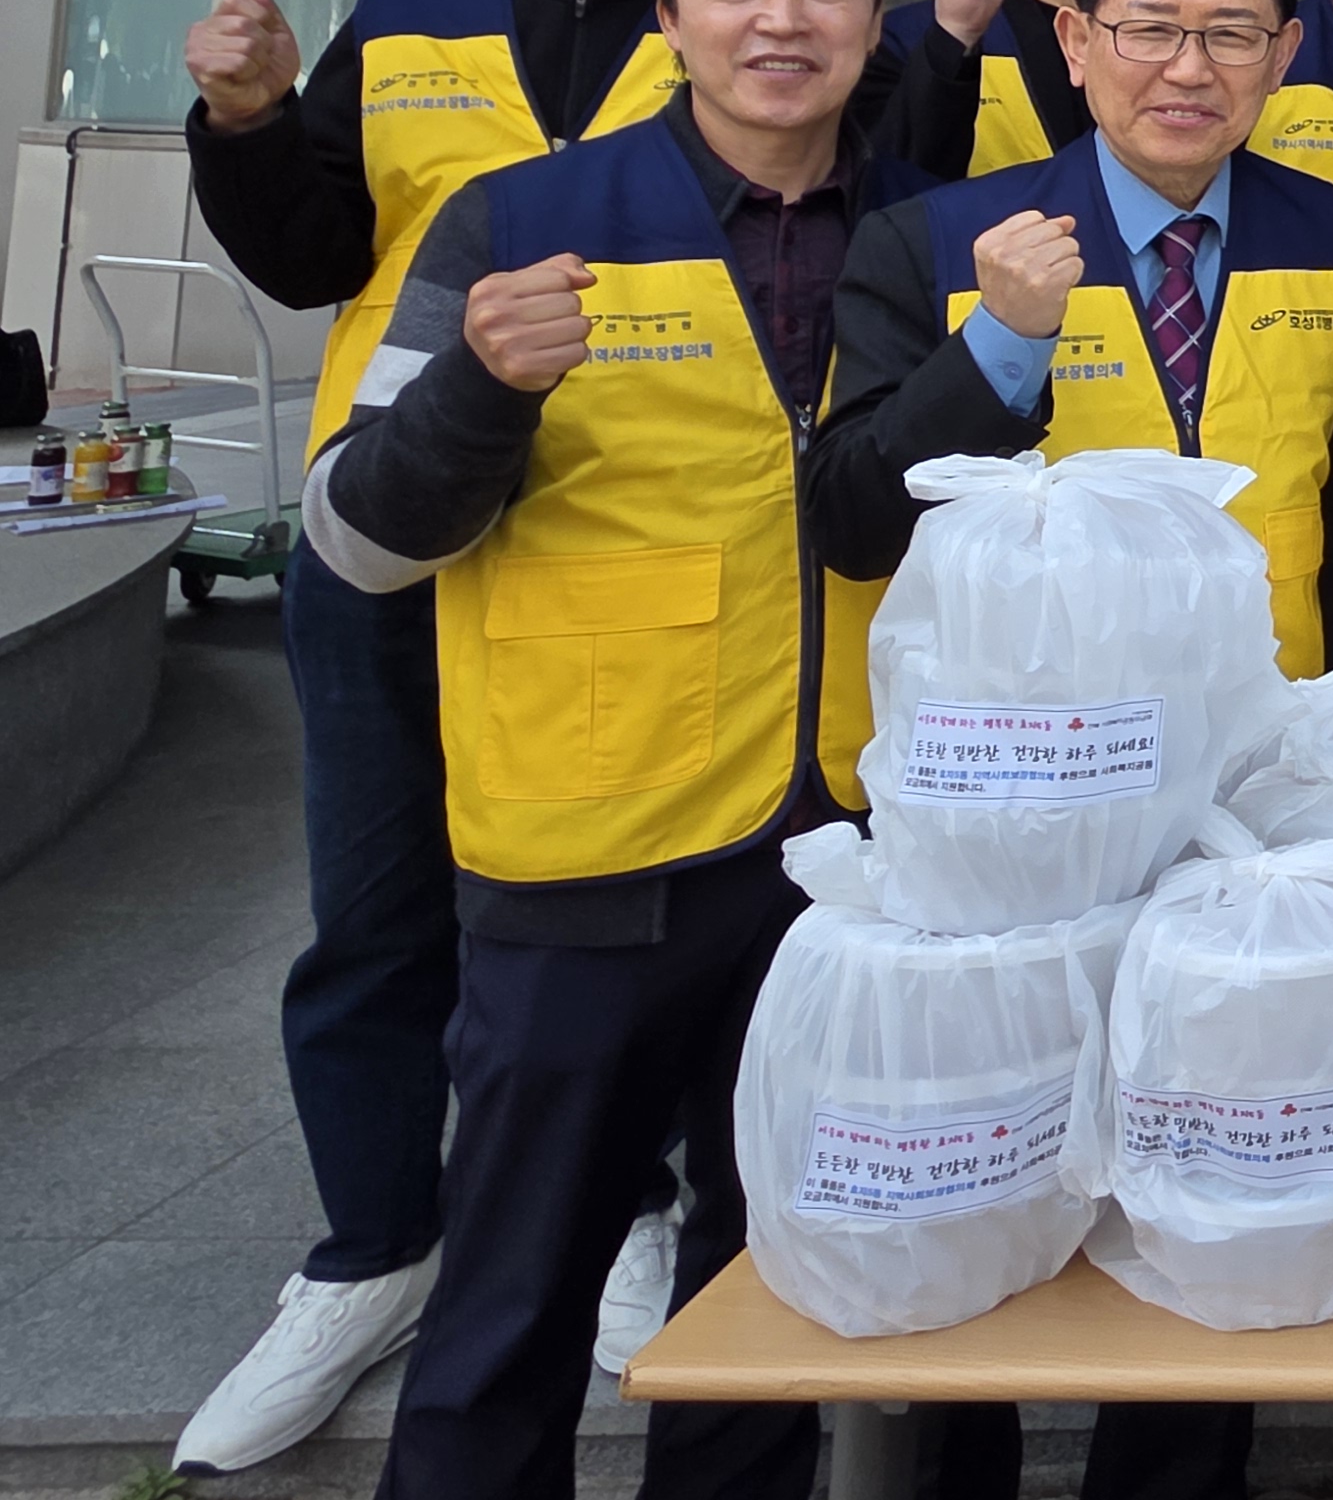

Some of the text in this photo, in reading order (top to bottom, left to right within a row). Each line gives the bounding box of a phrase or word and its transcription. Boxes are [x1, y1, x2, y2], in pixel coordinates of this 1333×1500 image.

[915, 737, 1154, 764] 든든한 밑반찬 건강한 하루 되세요!
[1174, 1116, 1217, 1138] 밑반찬
[1225, 1130, 1272, 1148] 건강한
[1279, 1130, 1311, 1143] 하루
[815, 1148, 1018, 1183] 든든한 밑반찬 건강한 하루
